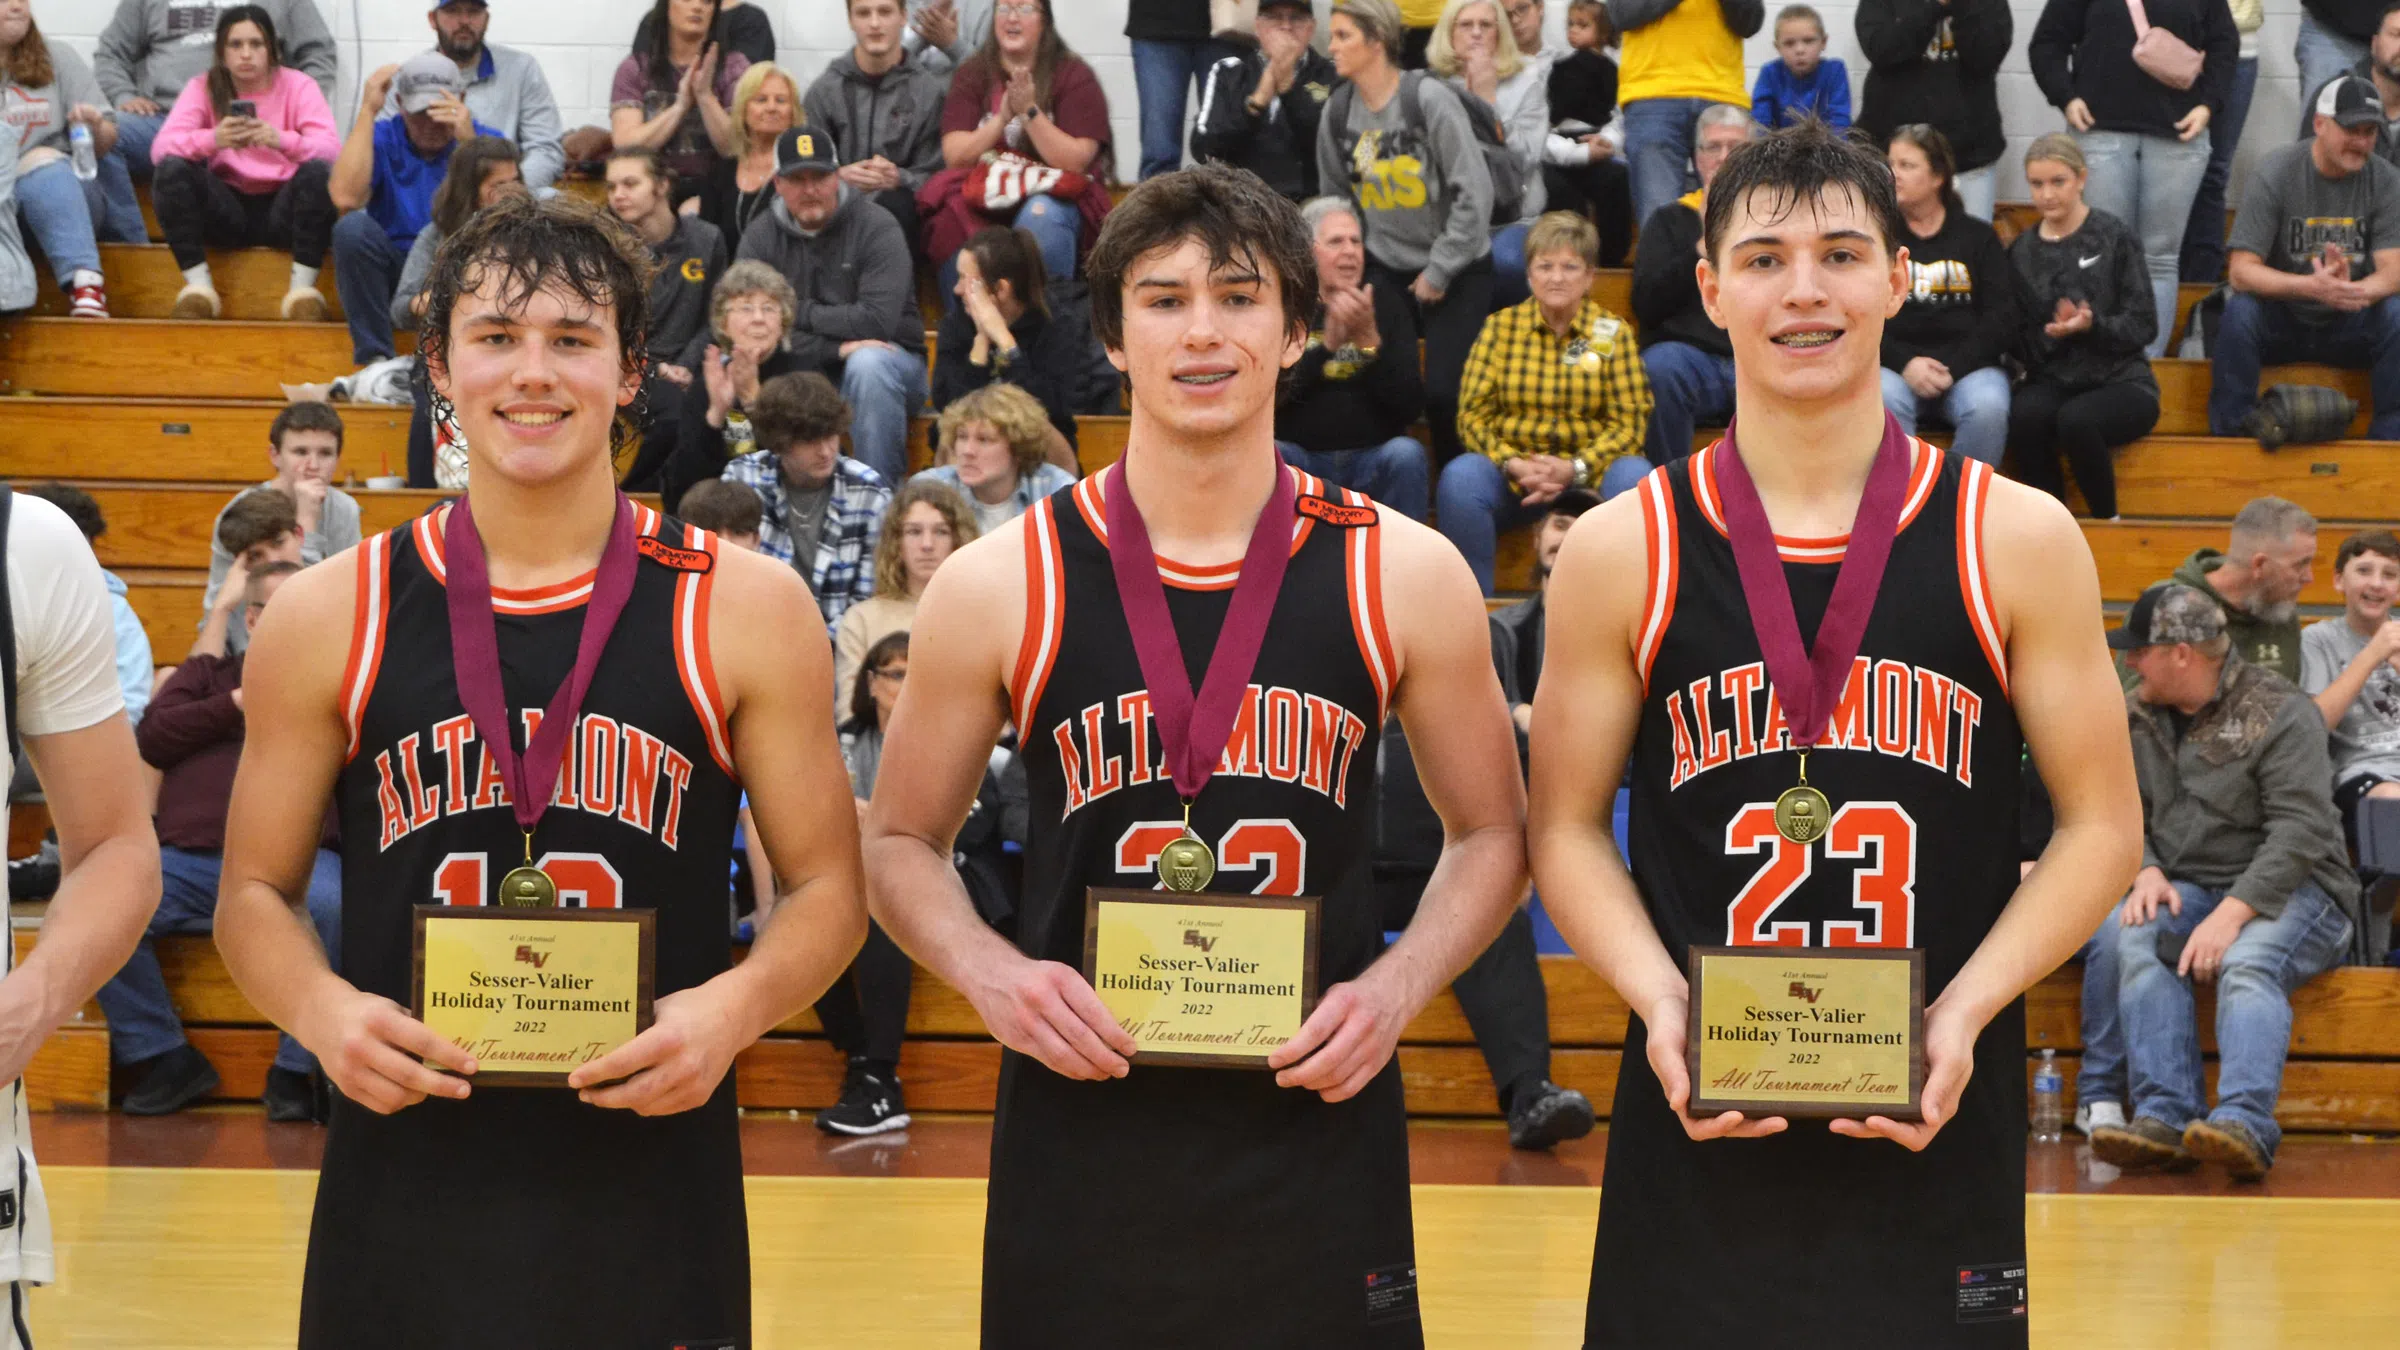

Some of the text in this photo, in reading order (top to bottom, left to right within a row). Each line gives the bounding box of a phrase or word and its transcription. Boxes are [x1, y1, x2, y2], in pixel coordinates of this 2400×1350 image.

[681, 258, 705, 282] G
[1724, 801, 1917, 949] 23
[1139, 954, 1260, 974] Sesser-Valier
[469, 971, 594, 990] Sesser-Valier
[1102, 974, 1296, 997] Holiday Tournament
[431, 991, 631, 1014] Holiday Tournament
[1181, 1003, 1214, 1016] 2022
[1744, 1006, 1866, 1024] Sesser-Valier
[513, 1021, 547, 1033] 2022
[1145, 1020, 1245, 1045] Tournament
[1708, 1025, 1904, 1046] Holiday Tournament
[476, 1039, 578, 1063] Tournament
[1788, 1053, 1821, 1065] 2022
[1712, 1067, 1899, 1094] All Tournament Team
